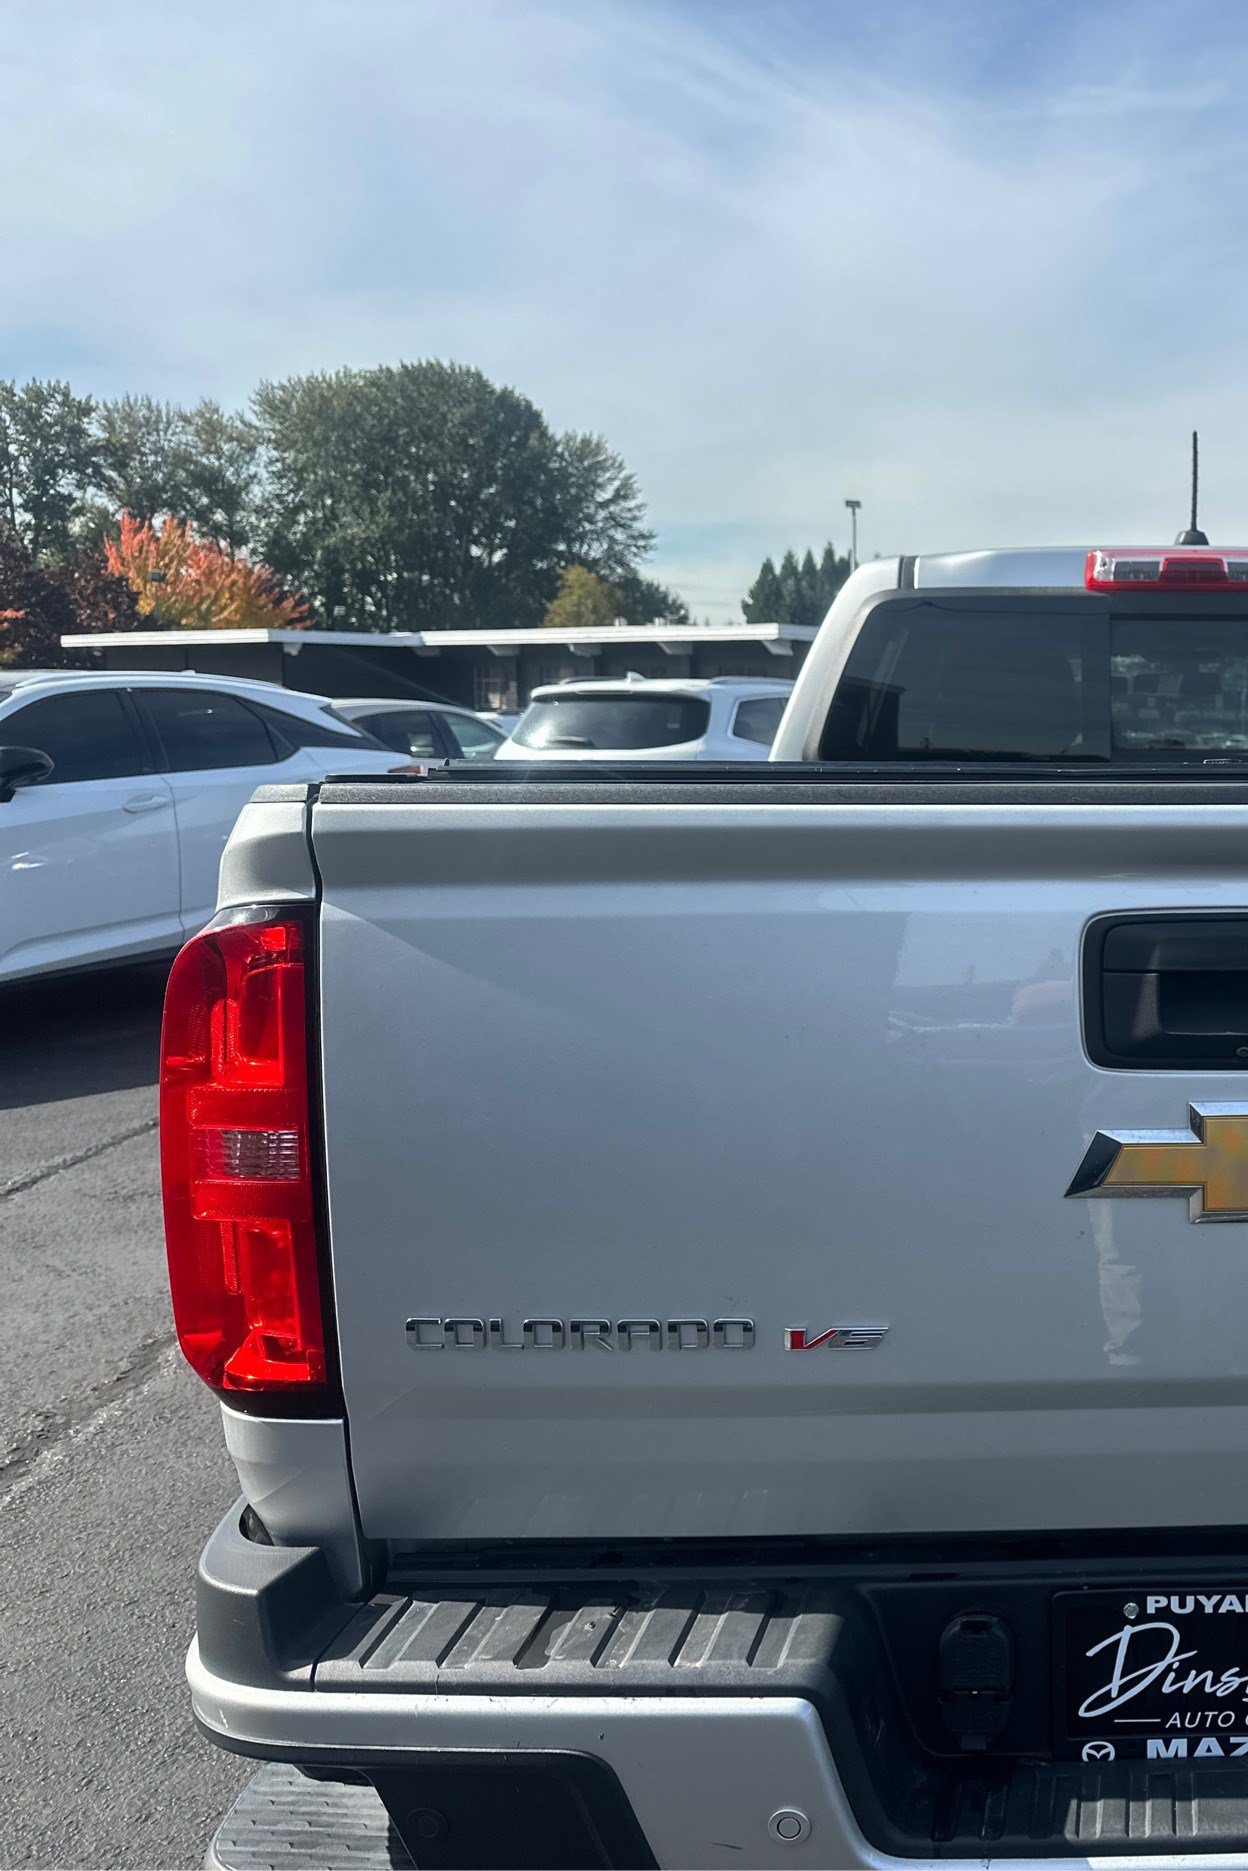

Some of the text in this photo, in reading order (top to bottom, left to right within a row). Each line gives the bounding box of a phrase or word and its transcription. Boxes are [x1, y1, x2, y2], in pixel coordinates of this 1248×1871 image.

[405, 1318, 891, 1352] COLORADO V6
[1165, 1711, 1235, 1728] AUTO
